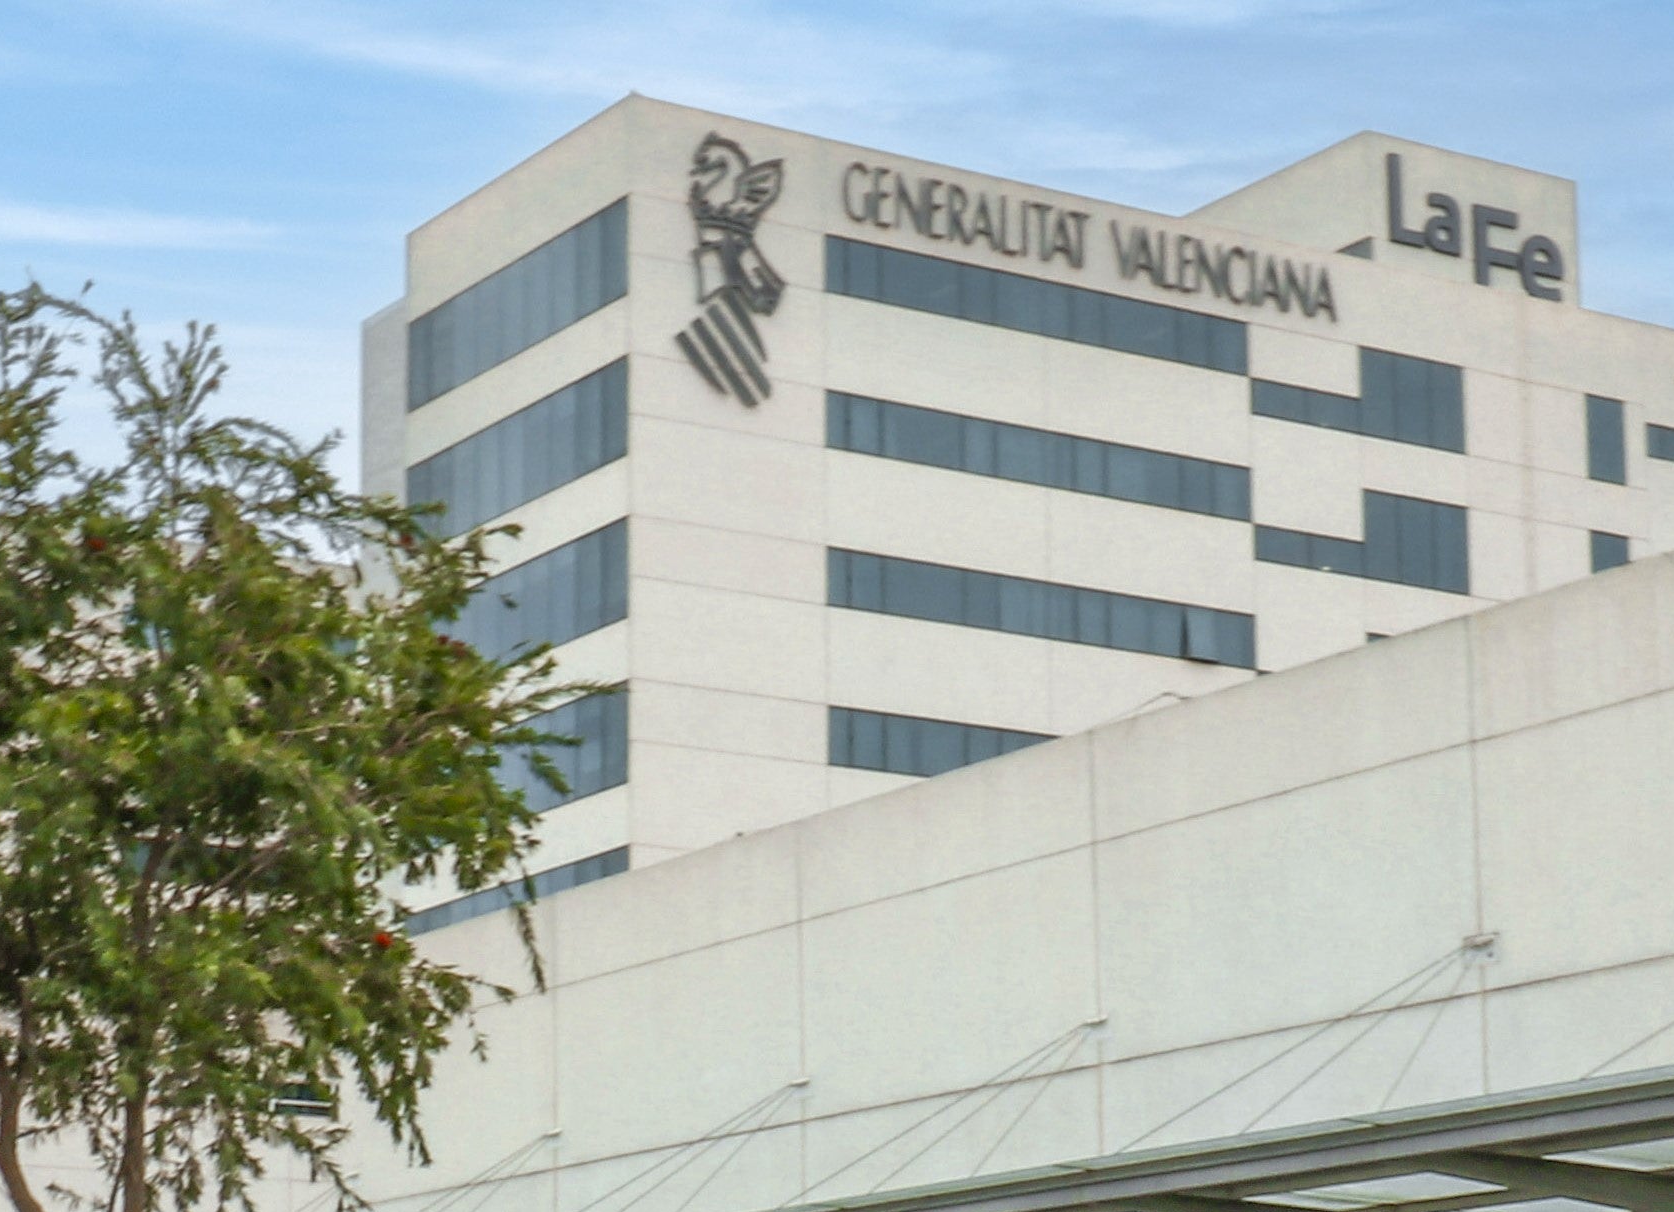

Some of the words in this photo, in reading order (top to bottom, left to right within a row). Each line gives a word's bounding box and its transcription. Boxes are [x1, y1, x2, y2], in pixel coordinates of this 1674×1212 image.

[841, 162, 1093, 269] GENERALITAT
[1109, 219, 1339, 322] VALENCIANA
[1386, 154, 1462, 257] La
[1472, 204, 1564, 301] Fe
